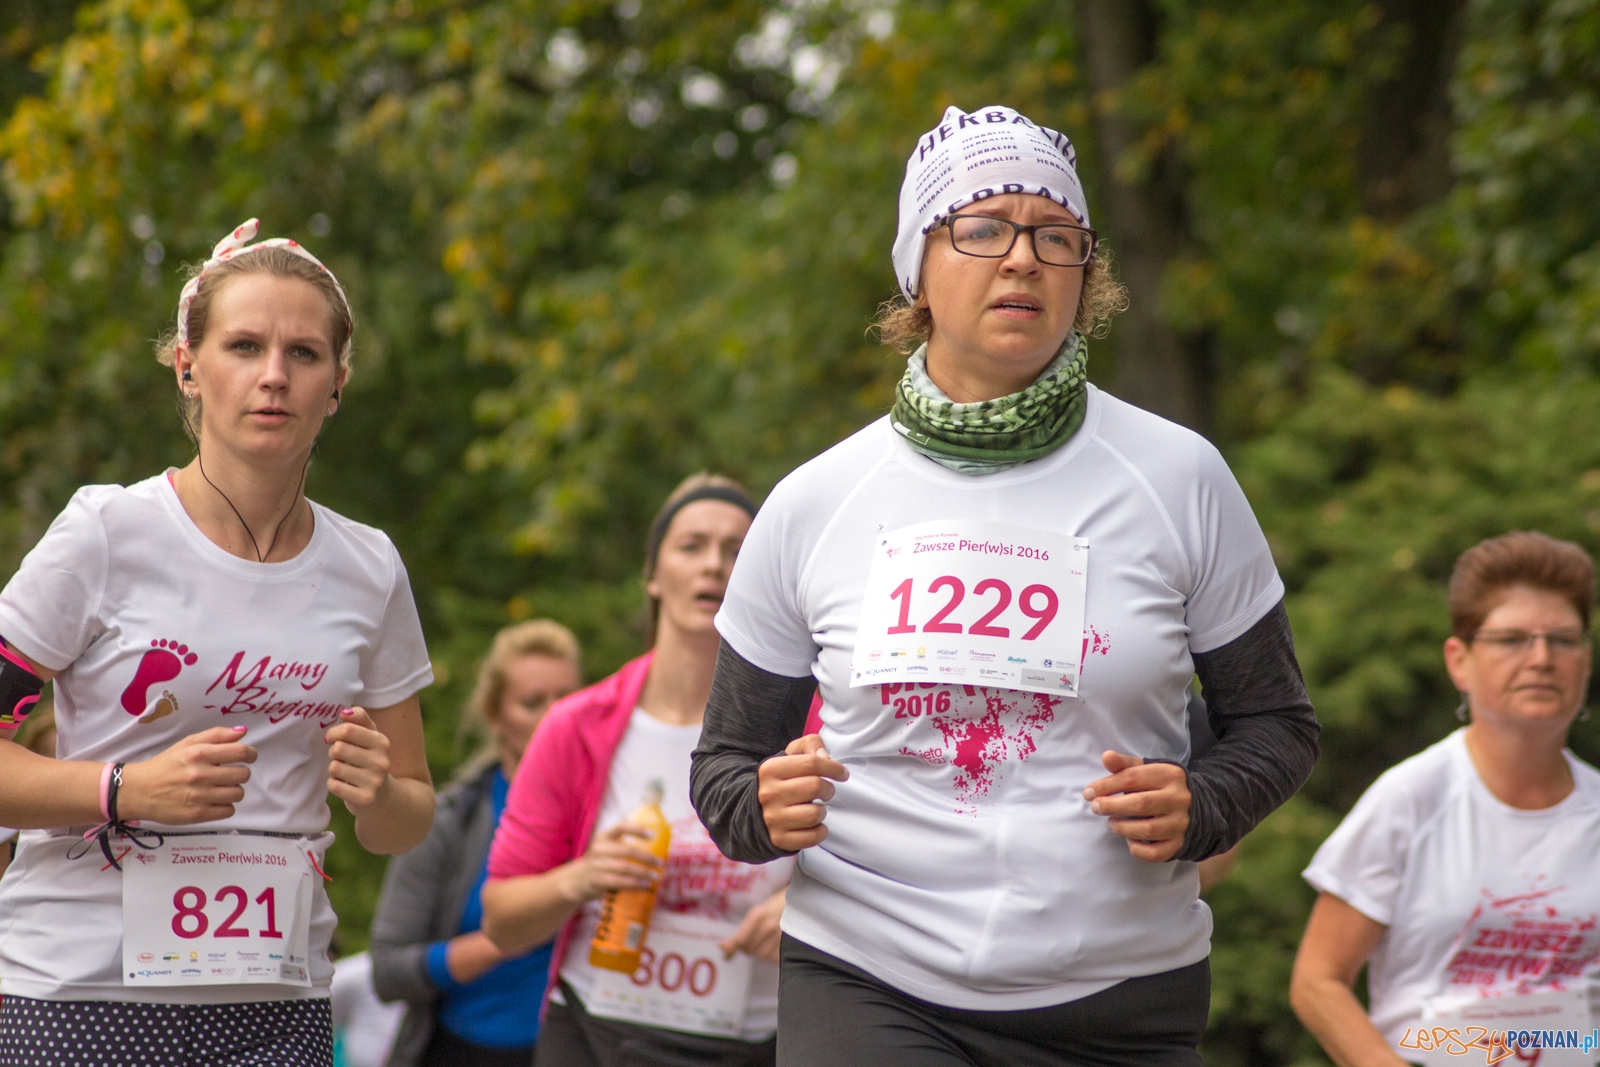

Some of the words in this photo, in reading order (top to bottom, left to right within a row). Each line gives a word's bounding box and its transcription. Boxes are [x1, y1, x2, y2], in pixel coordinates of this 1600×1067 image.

[963, 136, 1015, 151] HERBALIFE
[965, 145, 1018, 160] HERBALIFE
[967, 156, 1021, 171] HERBALIFE
[1036, 158, 1076, 186] HERBALIFE
[916, 165, 953, 203] HERBALIFE
[918, 177, 954, 214] HERBALIFE
[913, 539, 956, 554] Zawsze
[959, 539, 1013, 557] Pier(w)si
[1016, 546, 1050, 562] 2016
[887, 575, 1059, 641] 1229
[204, 650, 329, 697] Mamy
[939, 666, 967, 674] SHEFOOT
[892, 691, 951, 719] 2016
[171, 853, 215, 864] Zawsze
[218, 852, 263, 866] Pier(w)si
[265, 854, 287, 866] 2016
[171, 885, 283, 939] 821
